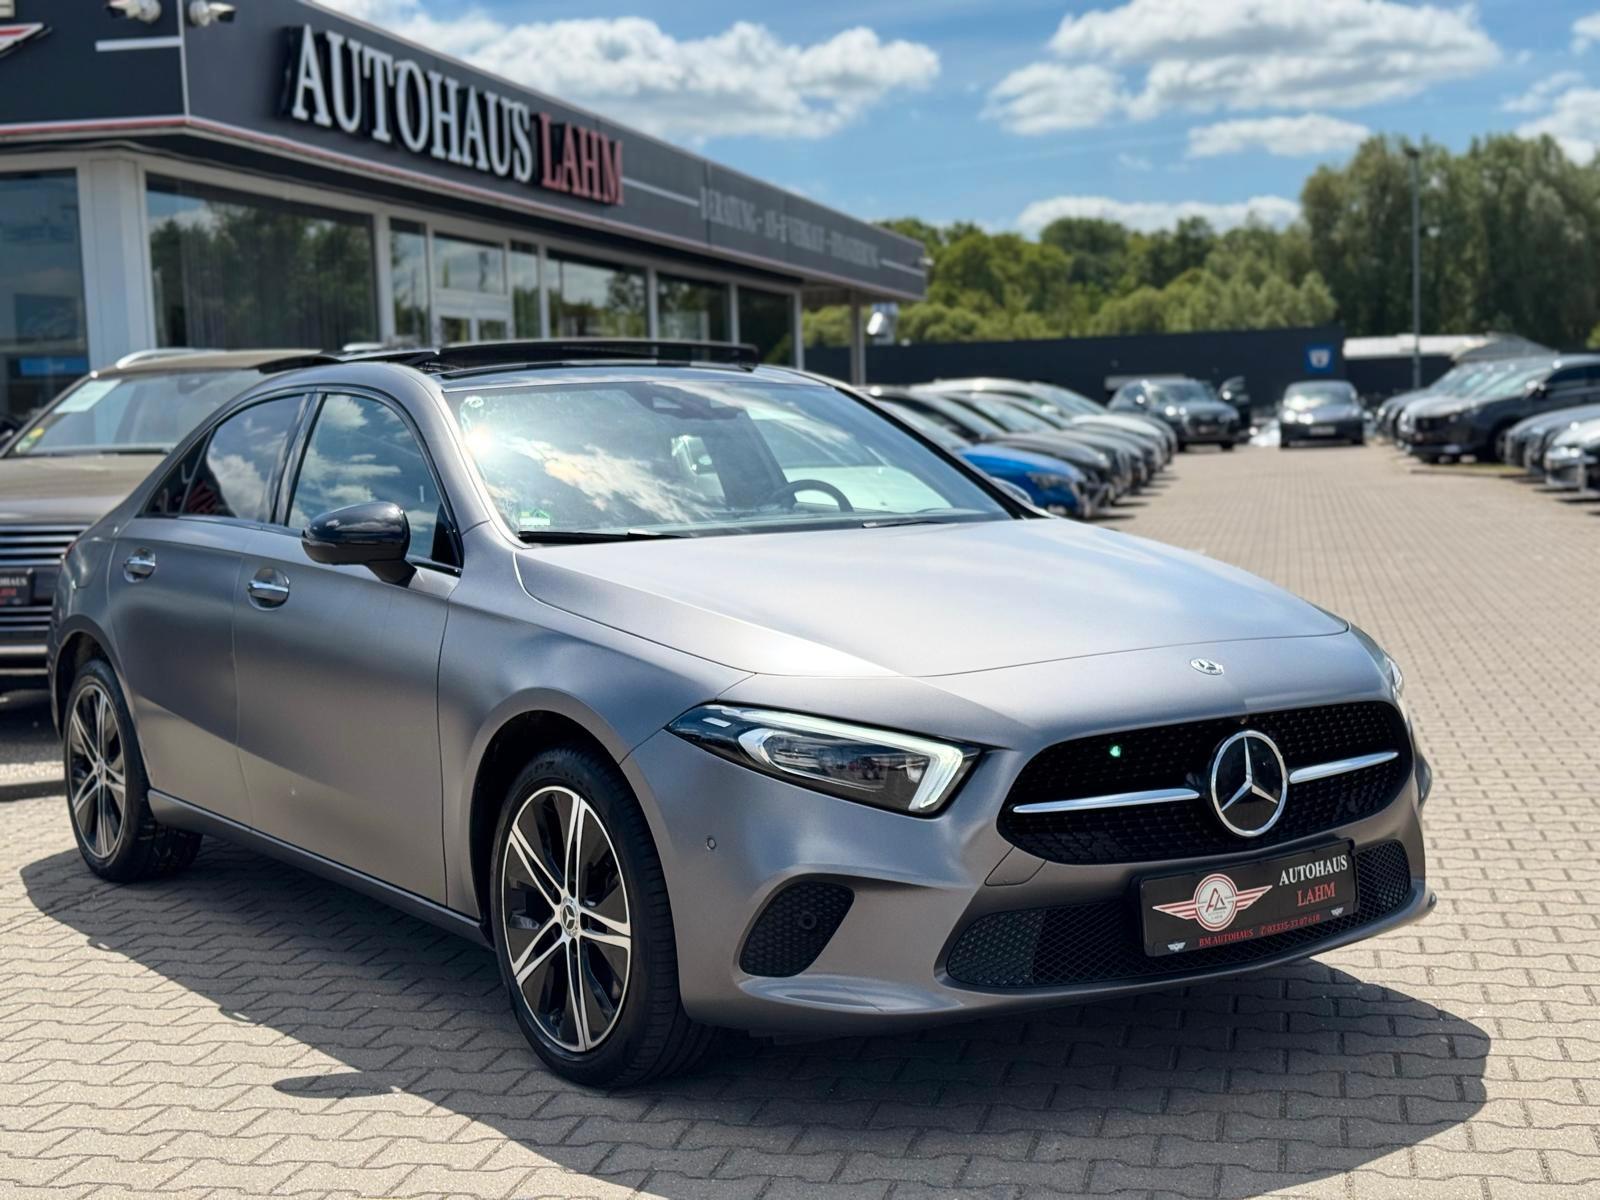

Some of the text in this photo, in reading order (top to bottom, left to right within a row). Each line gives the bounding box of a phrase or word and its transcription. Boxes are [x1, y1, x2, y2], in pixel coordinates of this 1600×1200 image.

[292, 24, 623, 205] AUTOHAUS LAHM
[1279, 854, 1348, 887] AUTOHAUS
[1297, 881, 1336, 907] LAHM
